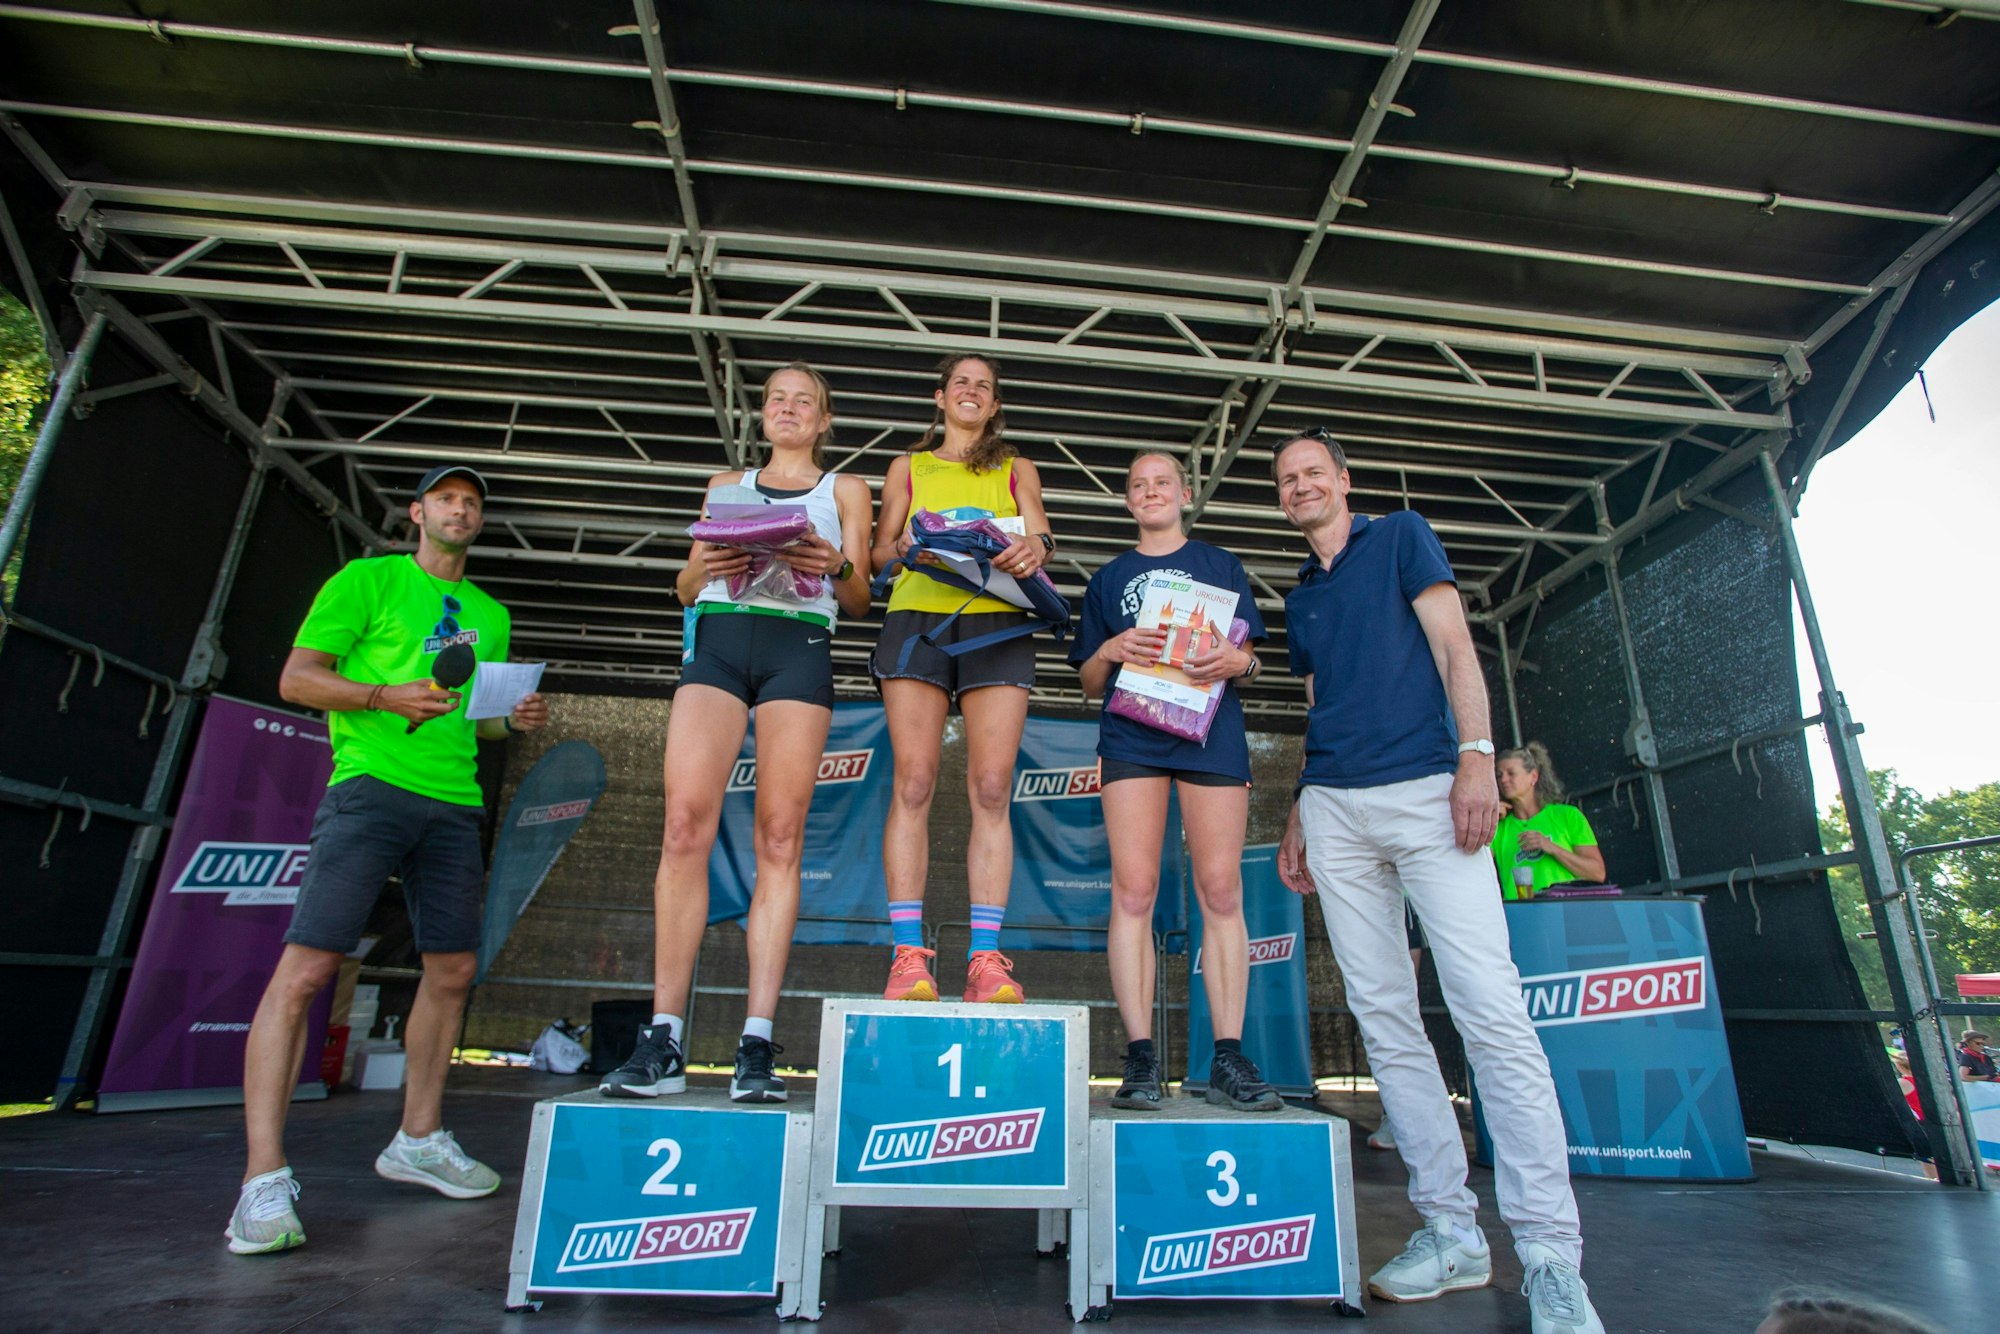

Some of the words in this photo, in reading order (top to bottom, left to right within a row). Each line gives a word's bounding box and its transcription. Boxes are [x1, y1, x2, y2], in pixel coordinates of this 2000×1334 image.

[1195, 590, 1233, 606] URKUNDE
[817, 757, 865, 779] ORT
[1586, 968, 1699, 1012] SPORT
[937, 1043, 987, 1098] 1.
[640, 1137, 698, 1196] 2.
[1567, 1144, 1692, 1160] www.unisport.koeln
[1205, 1149, 1258, 1207] 3.
